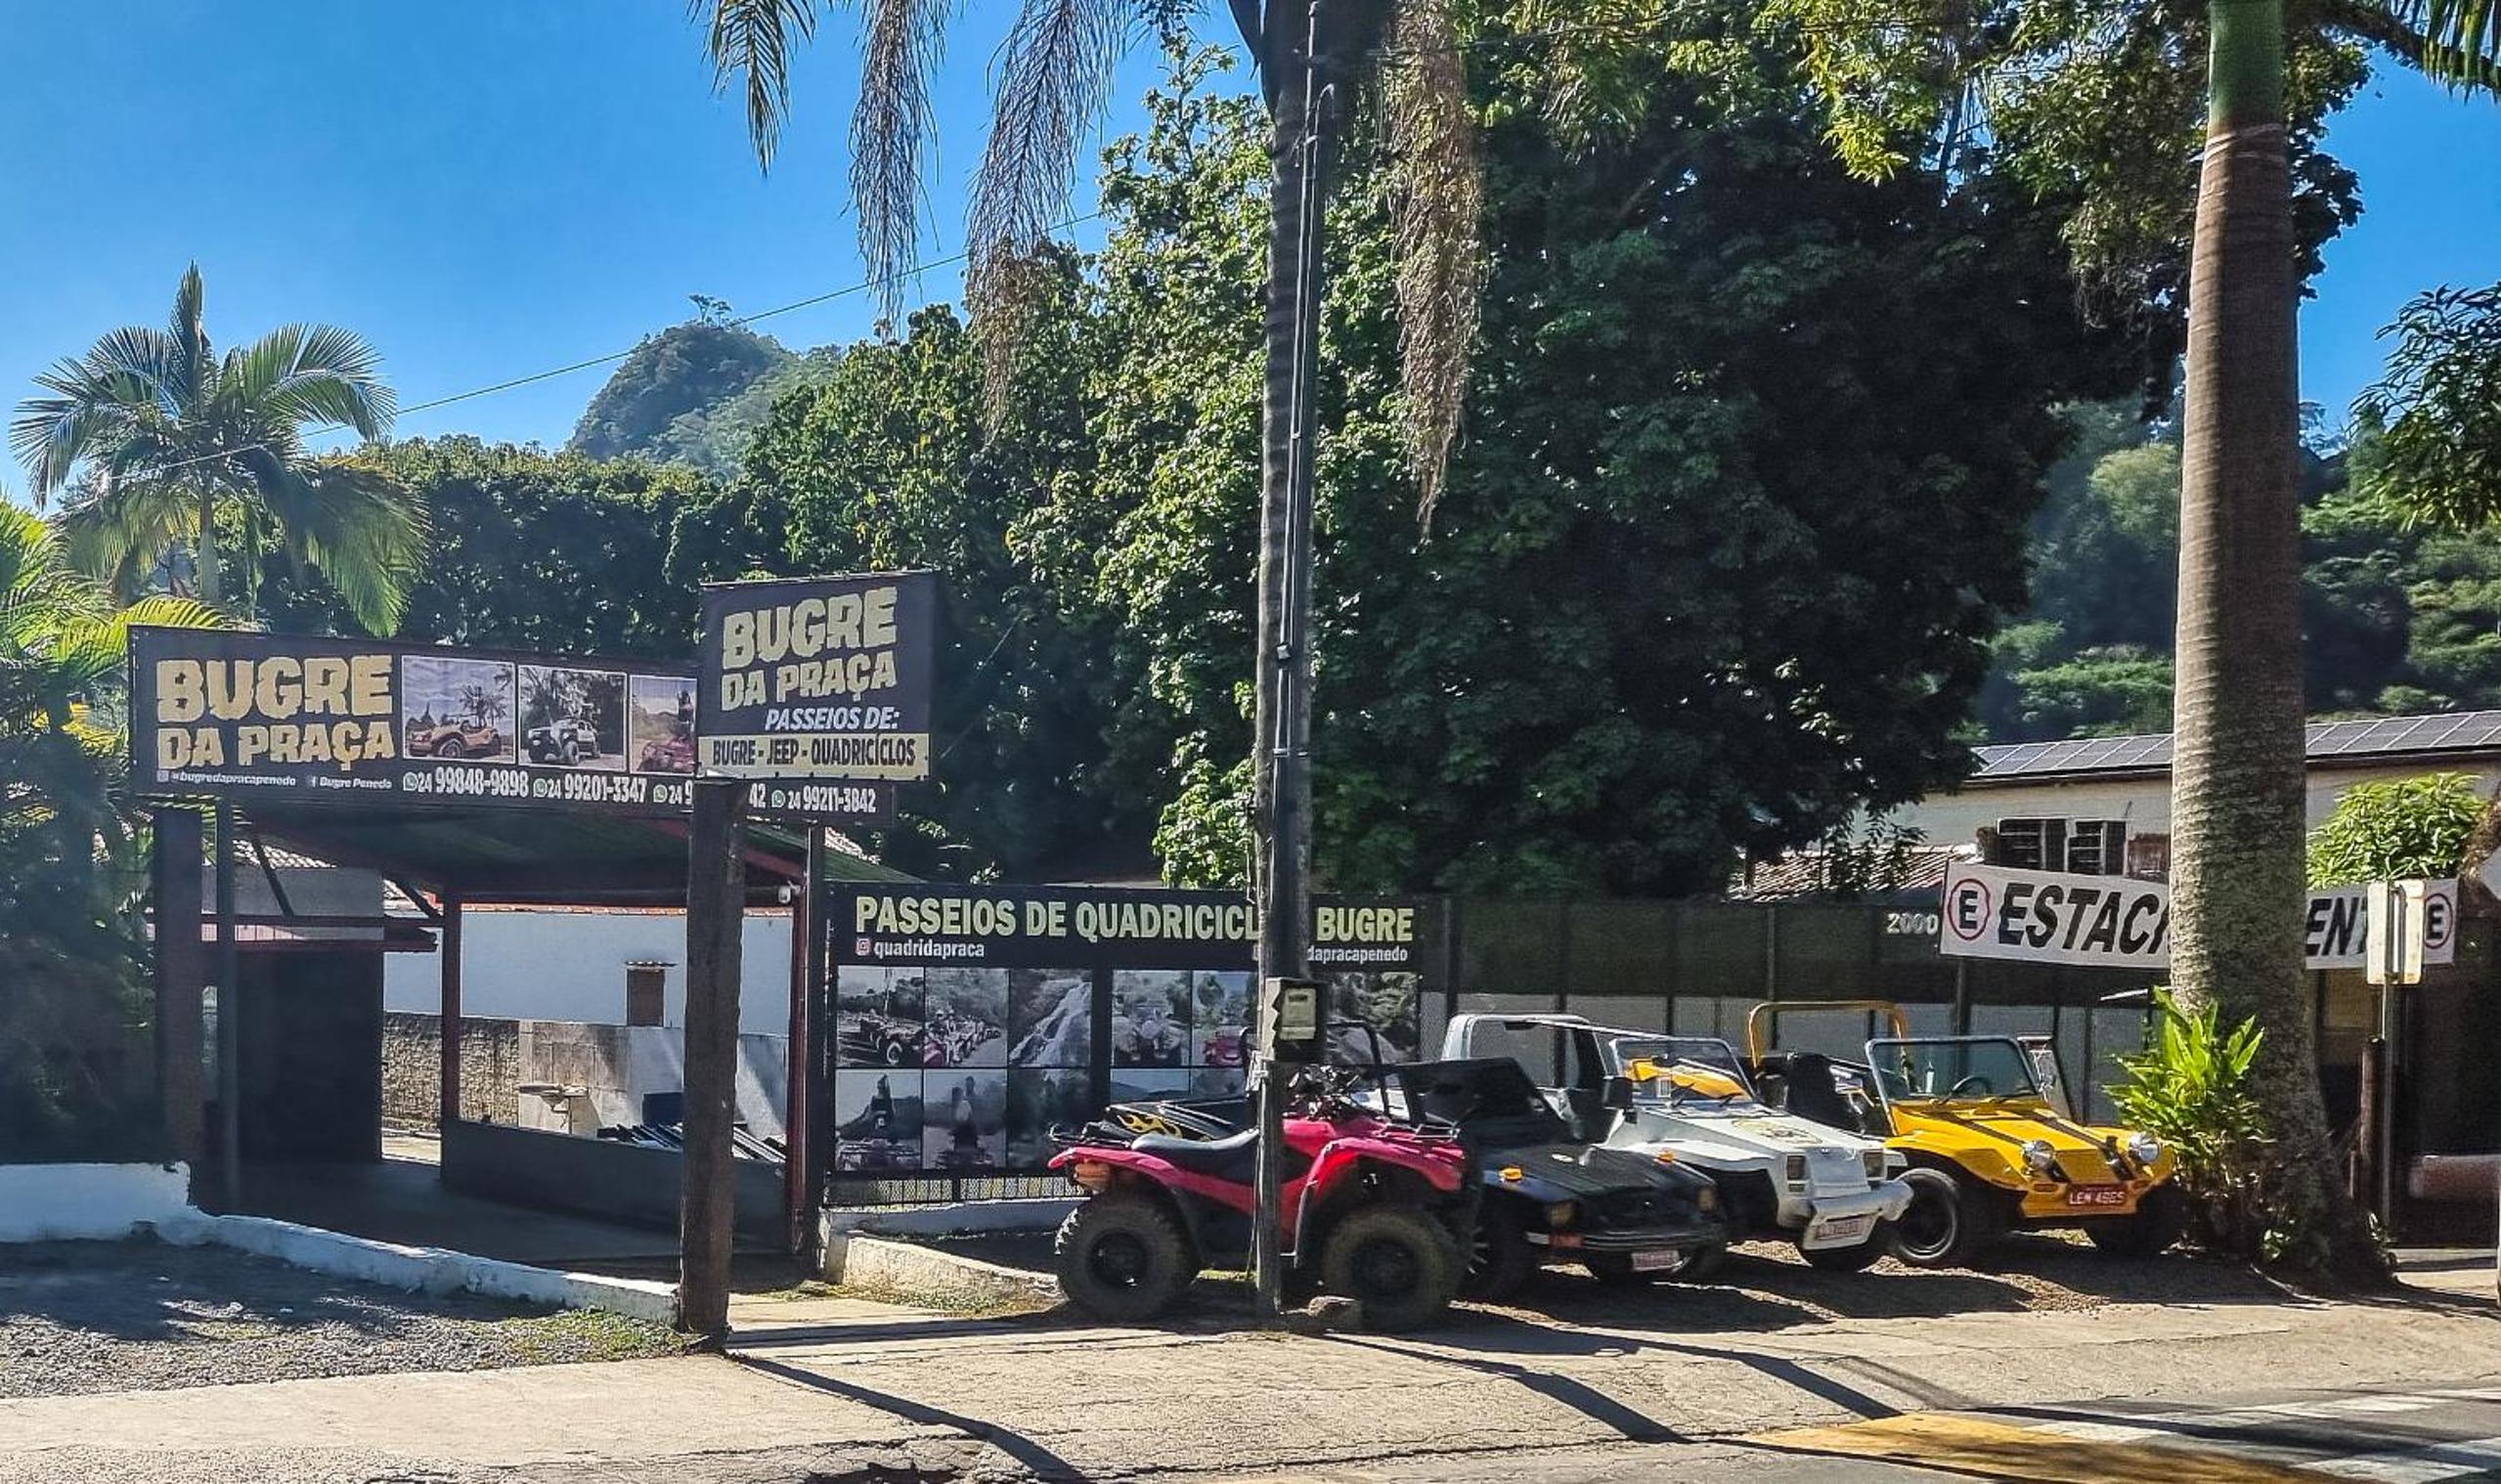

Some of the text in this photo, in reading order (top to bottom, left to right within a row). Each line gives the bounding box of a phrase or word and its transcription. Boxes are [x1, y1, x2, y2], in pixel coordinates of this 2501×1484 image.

[723, 587, 898, 670] BUGRE
[156, 655, 393, 722] BUGRE
[722, 650, 898, 712] DA PRAÇA
[765, 707, 900, 731] PASSEIOS DE:
[156, 721, 395, 770] DA PRAÇA
[713, 740, 756, 766] BUGRE
[767, 738, 799, 764] JEEP
[320, 776, 391, 790] Bugre Penedo
[417, 766, 529, 798] 24 99848-9898
[548, 773, 647, 803] 24 99201-3347
[668, 784, 682, 805] 24
[788, 792, 801, 809] 24
[803, 785, 876, 813] 99211-3842
[856, 895, 1415, 943] PASSEIOS DE QUADRICICL BUGRE
[1958, 890, 1978, 930] E
[873, 938, 985, 960] quadridapraca
[1307, 944, 1408, 964] dapracapenedo
